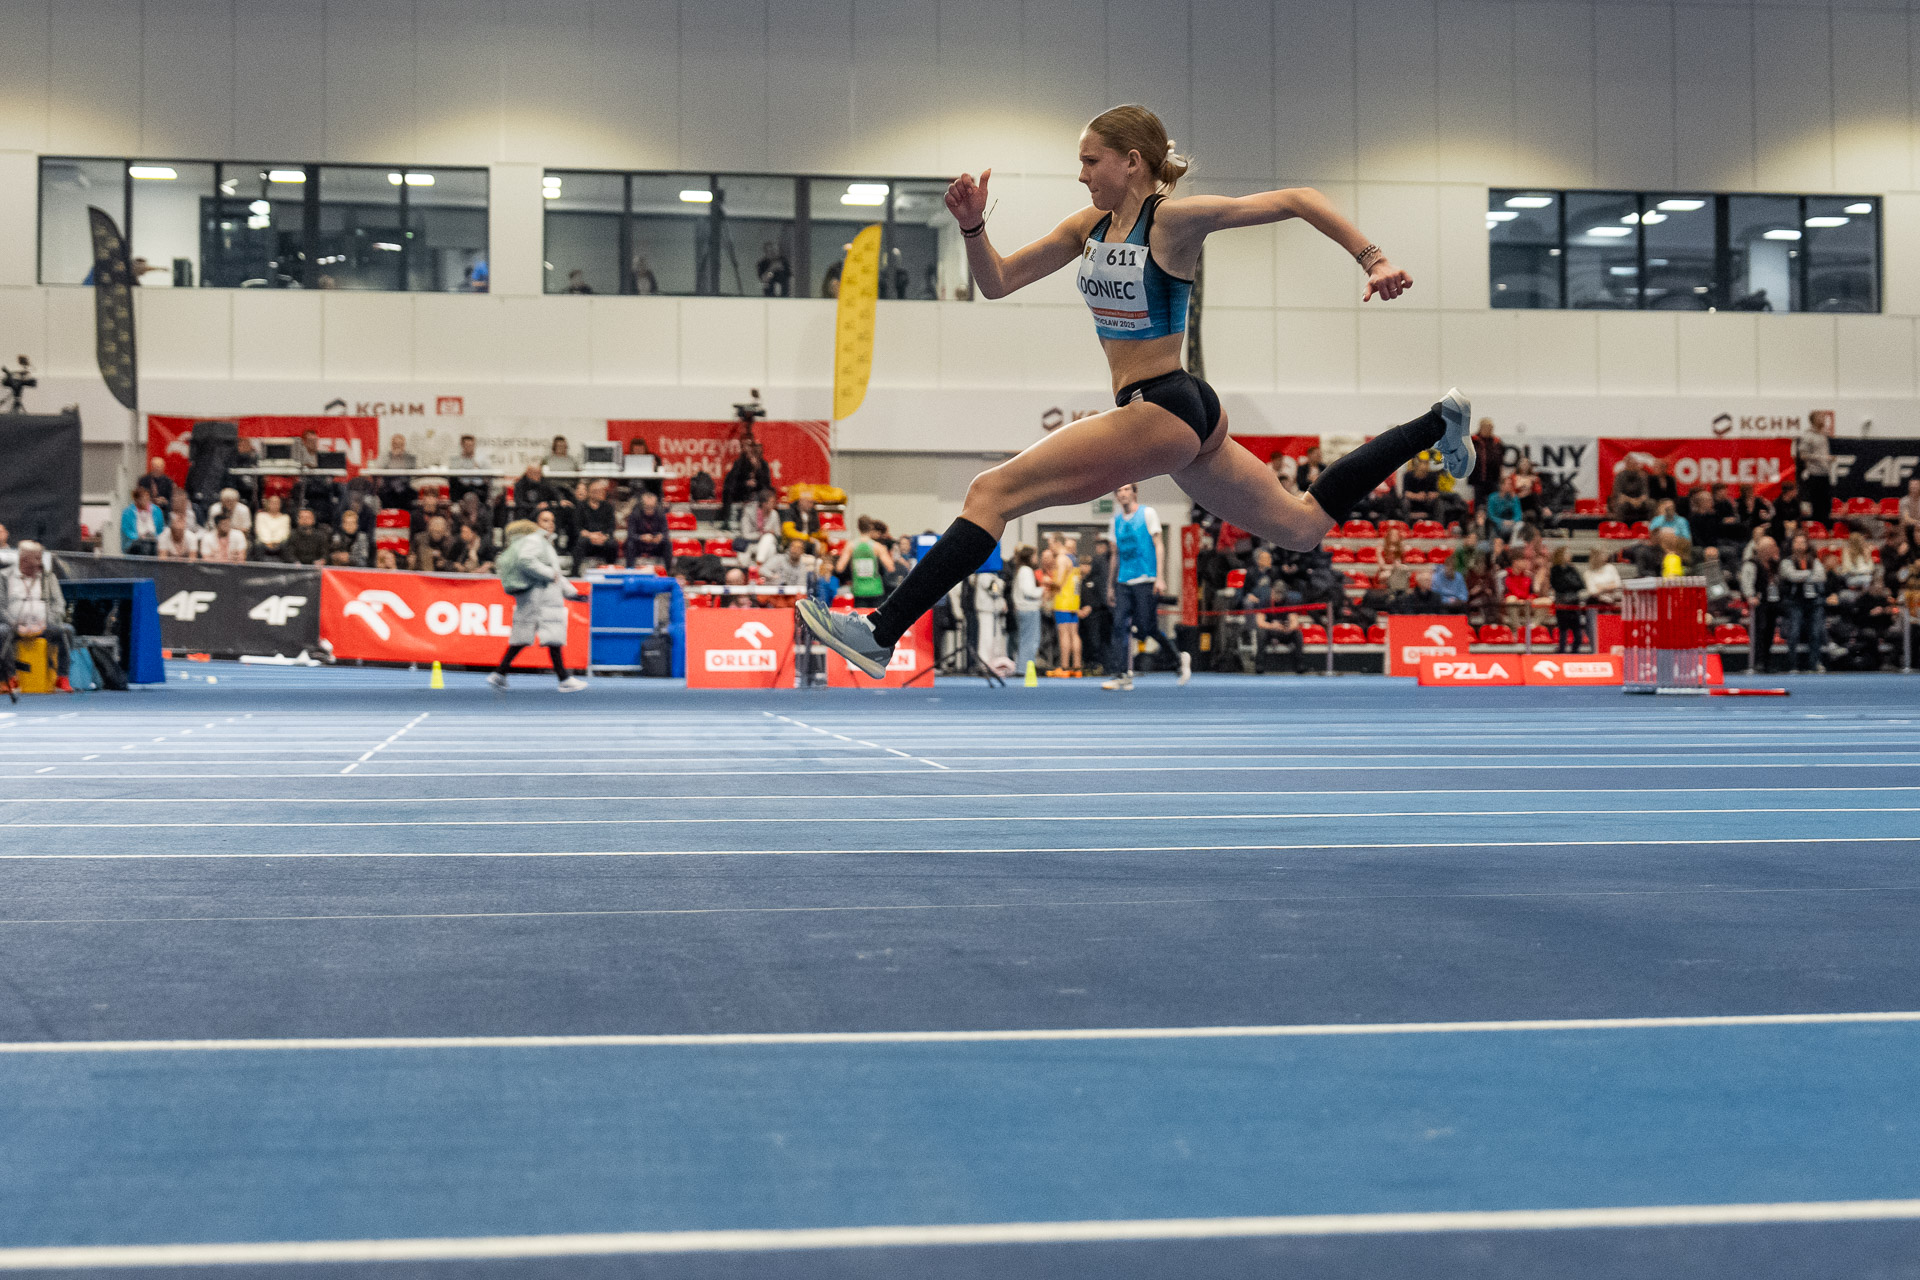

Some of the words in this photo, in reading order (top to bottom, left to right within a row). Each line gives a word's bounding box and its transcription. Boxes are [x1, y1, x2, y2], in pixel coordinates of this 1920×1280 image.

[1106, 249, 1136, 266] 611
[1080, 276, 1136, 300] DONIEC
[1120, 320, 1136, 329] 2025
[1501, 445, 1587, 467] OLNY
[1674, 457, 1781, 484] ORLEN
[1864, 456, 1919, 486] 4F
[158, 590, 217, 622] 4F
[248, 595, 308, 626] 4F
[425, 602, 512, 637] ORL
[711, 653, 771, 667] ORLEN
[1433, 662, 1510, 680] PZLA
